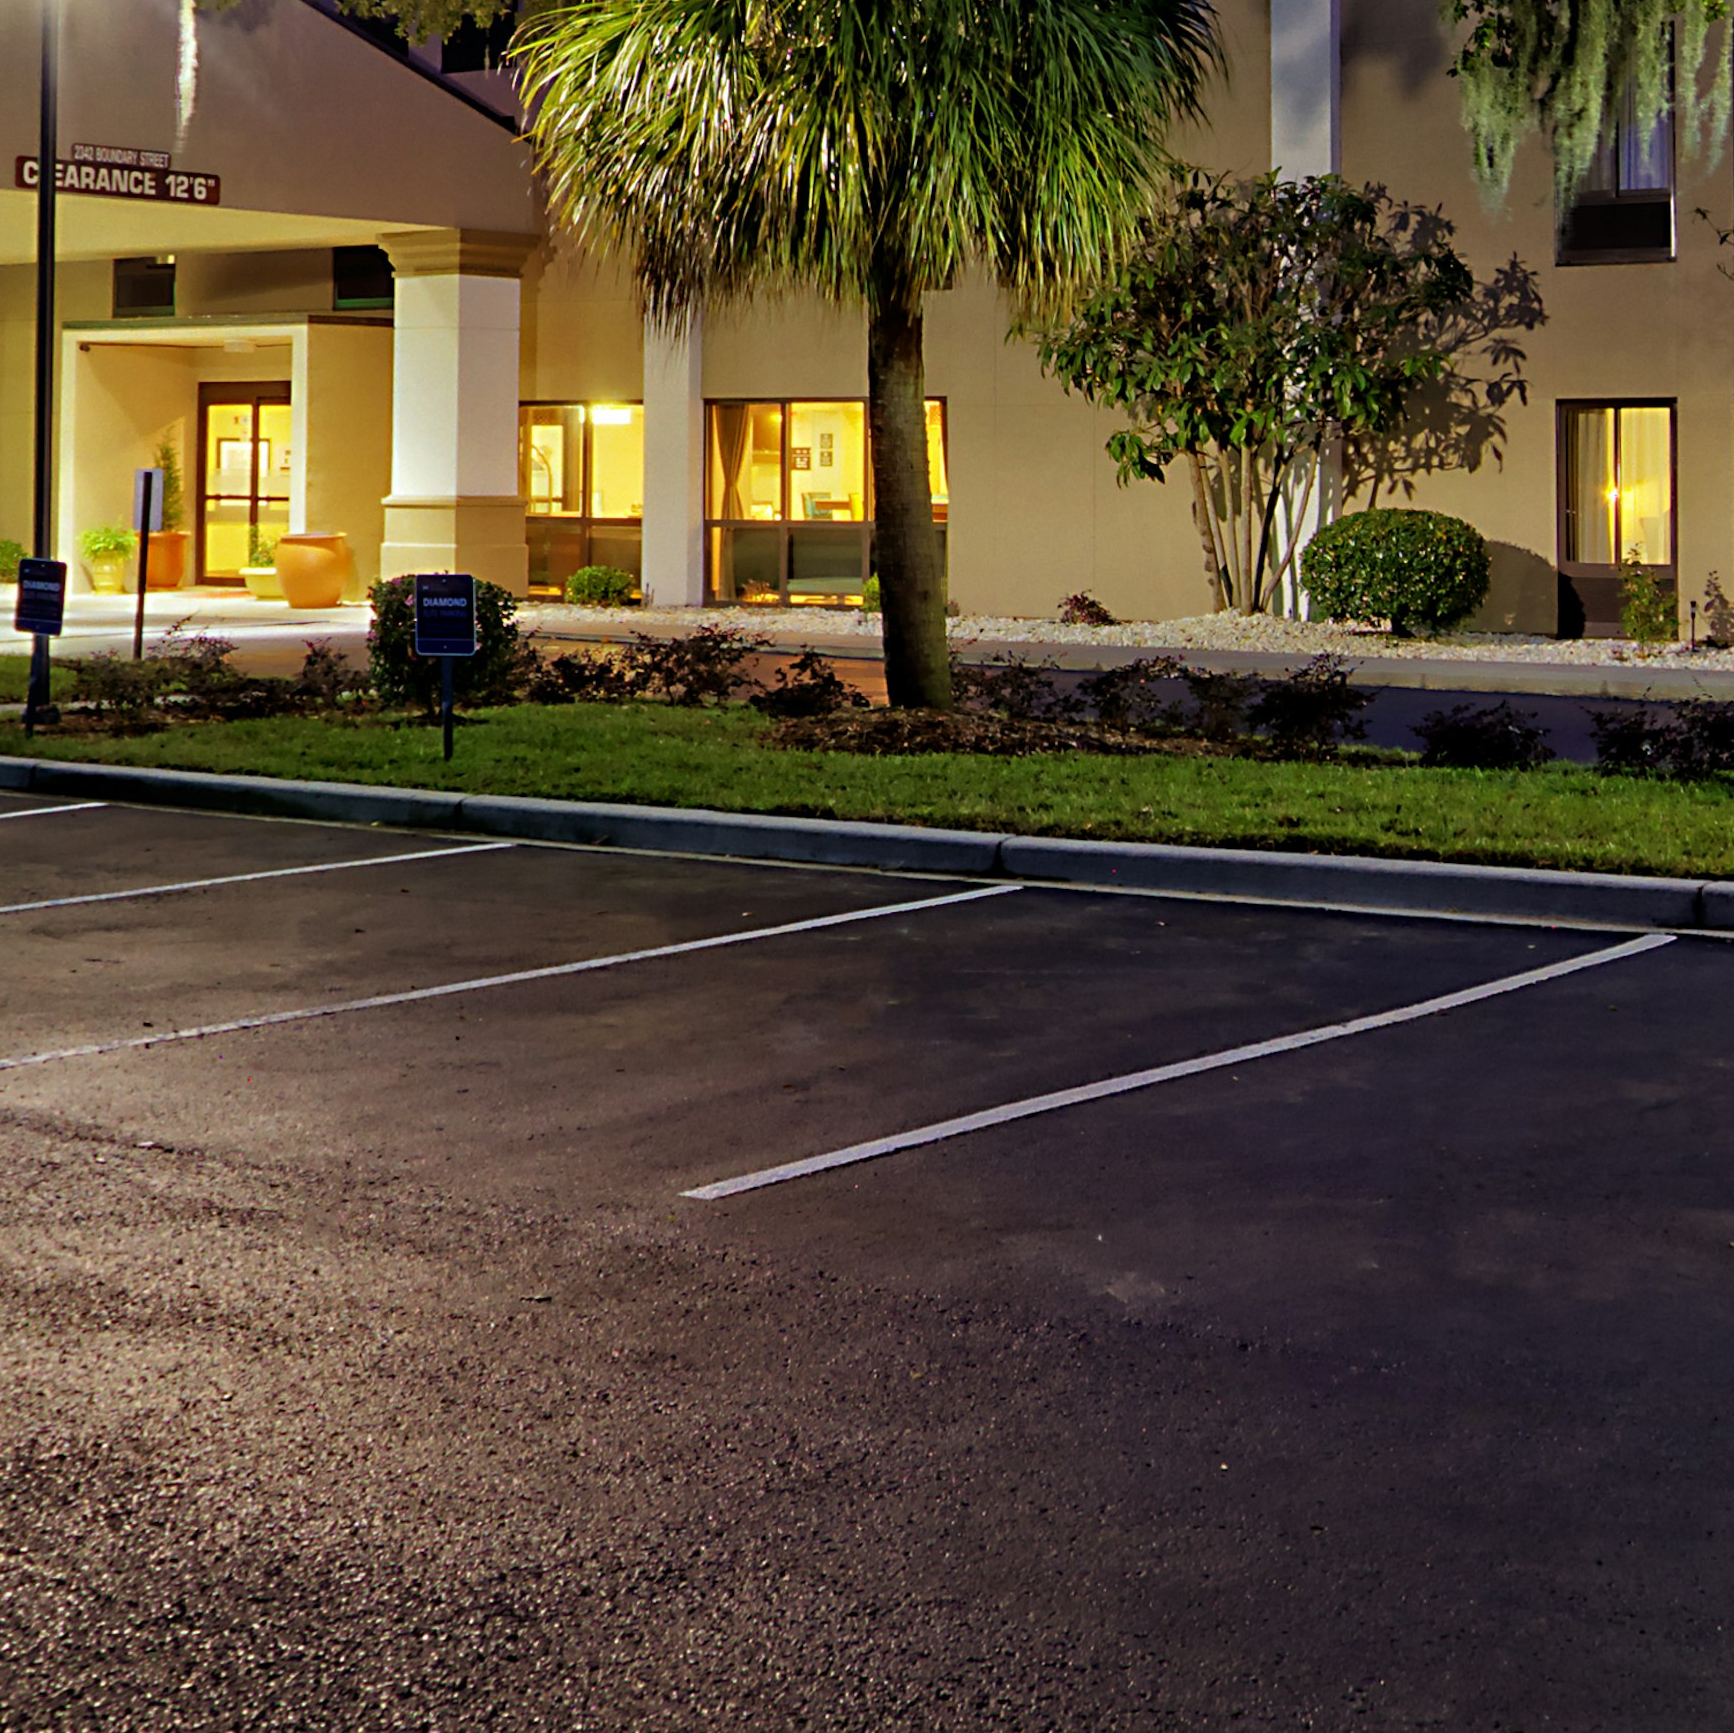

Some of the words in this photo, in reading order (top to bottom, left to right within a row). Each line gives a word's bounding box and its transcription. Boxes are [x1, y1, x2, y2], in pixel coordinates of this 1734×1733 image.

[96, 147, 138, 166] BOUNDARY
[140, 152, 169, 168] STREET
[23, 161, 156, 195] CEARANCE
[165, 174, 215, 200] 12'6"
[23, 580, 60, 592] DIAMOND
[423, 597, 467, 607] DIAMOND
